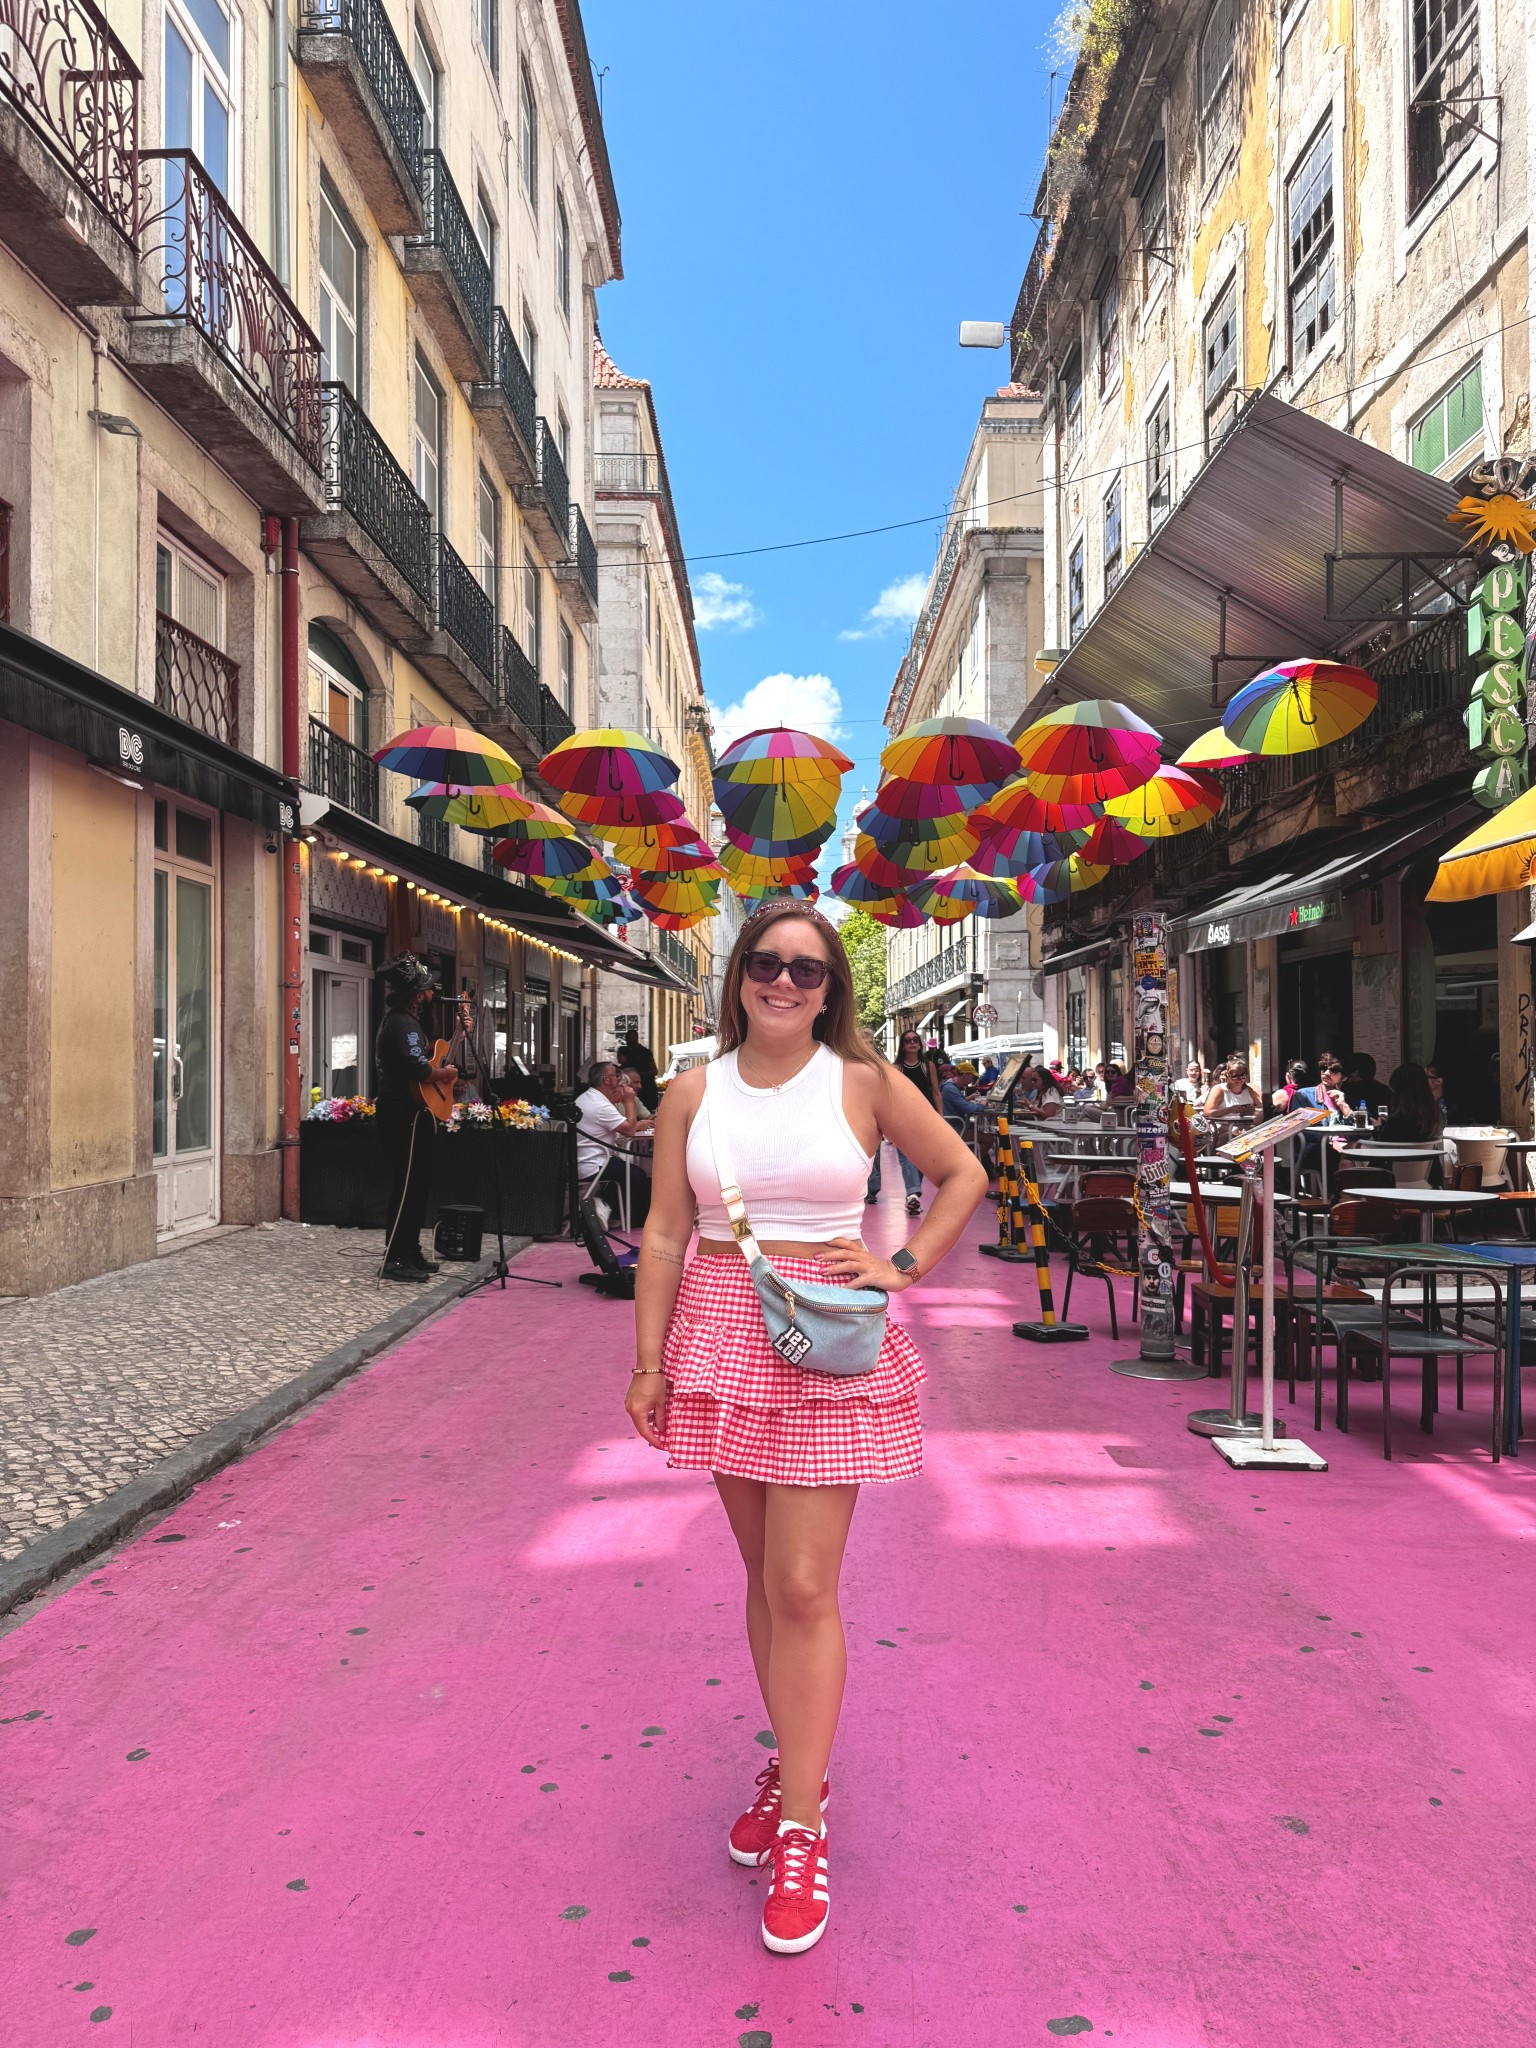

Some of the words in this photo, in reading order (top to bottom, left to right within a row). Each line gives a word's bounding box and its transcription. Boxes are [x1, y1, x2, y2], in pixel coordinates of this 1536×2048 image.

[1491, 567, 1517, 799] PESCA
[774, 1335, 803, 1364] LGB
[784, 1326, 811, 1353] 123
